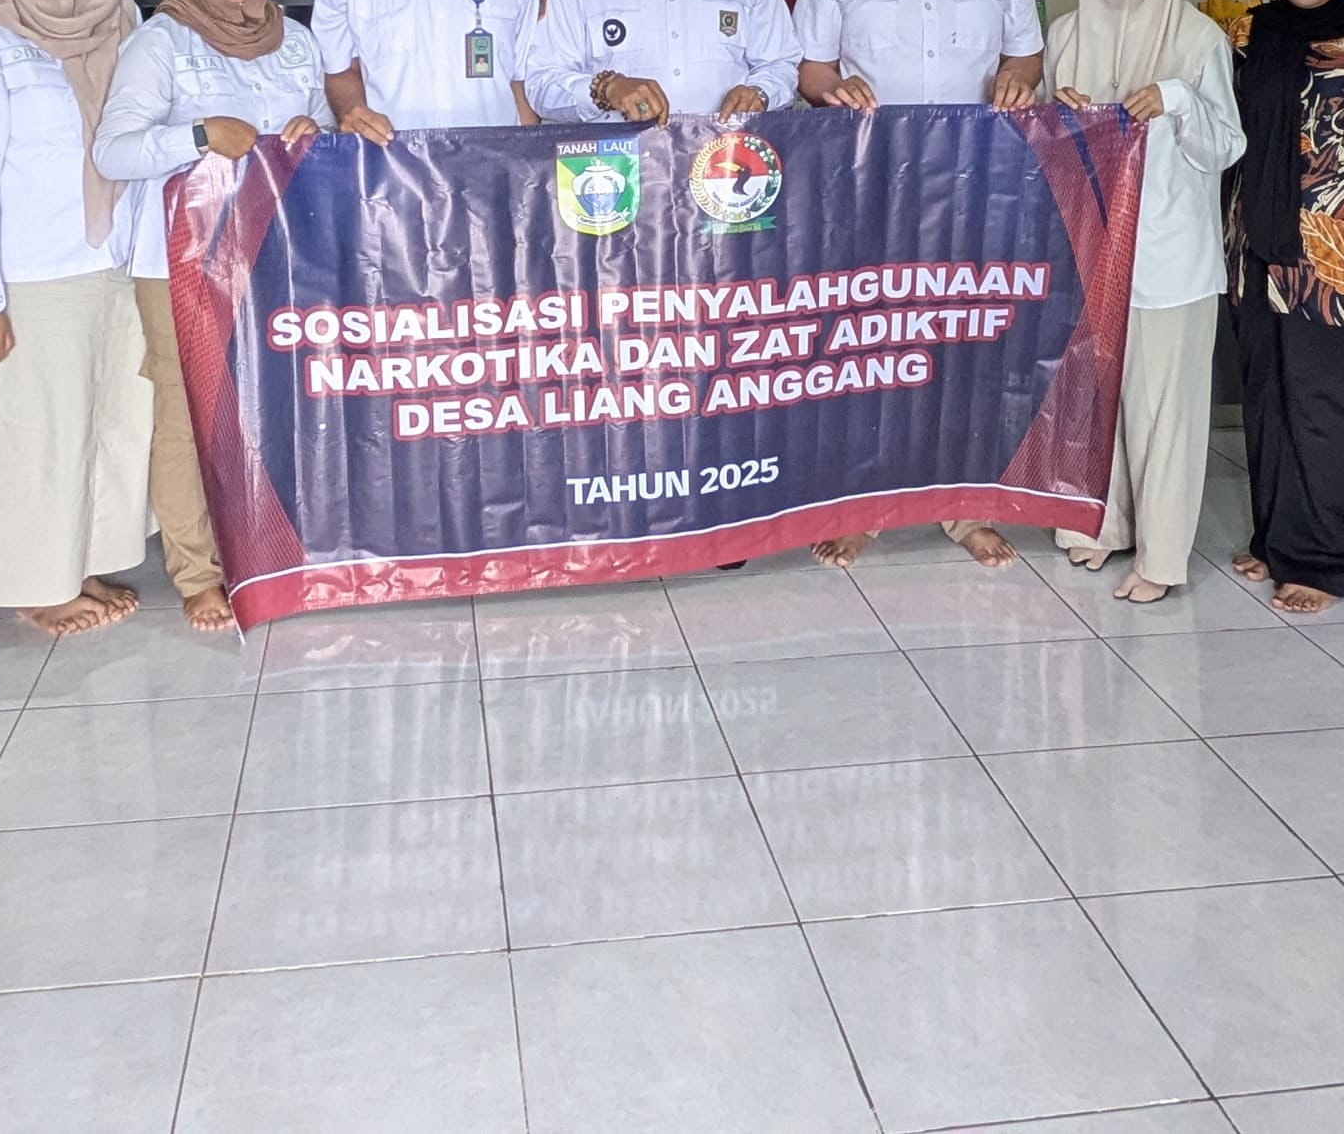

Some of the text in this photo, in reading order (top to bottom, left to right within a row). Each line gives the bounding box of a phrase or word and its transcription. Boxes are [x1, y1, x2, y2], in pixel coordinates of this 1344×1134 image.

[558, 140, 633, 155] TANAH LAUT
[271, 266, 1046, 347] SOSIALISASI PENYALAHGUNAAN
[309, 308, 1010, 393] NARKOTIKA DAN ZAT ADIKTIF
[397, 353, 929, 437] DESA LIANG ANGGANG
[566, 455, 780, 506] TAHUN 2025
